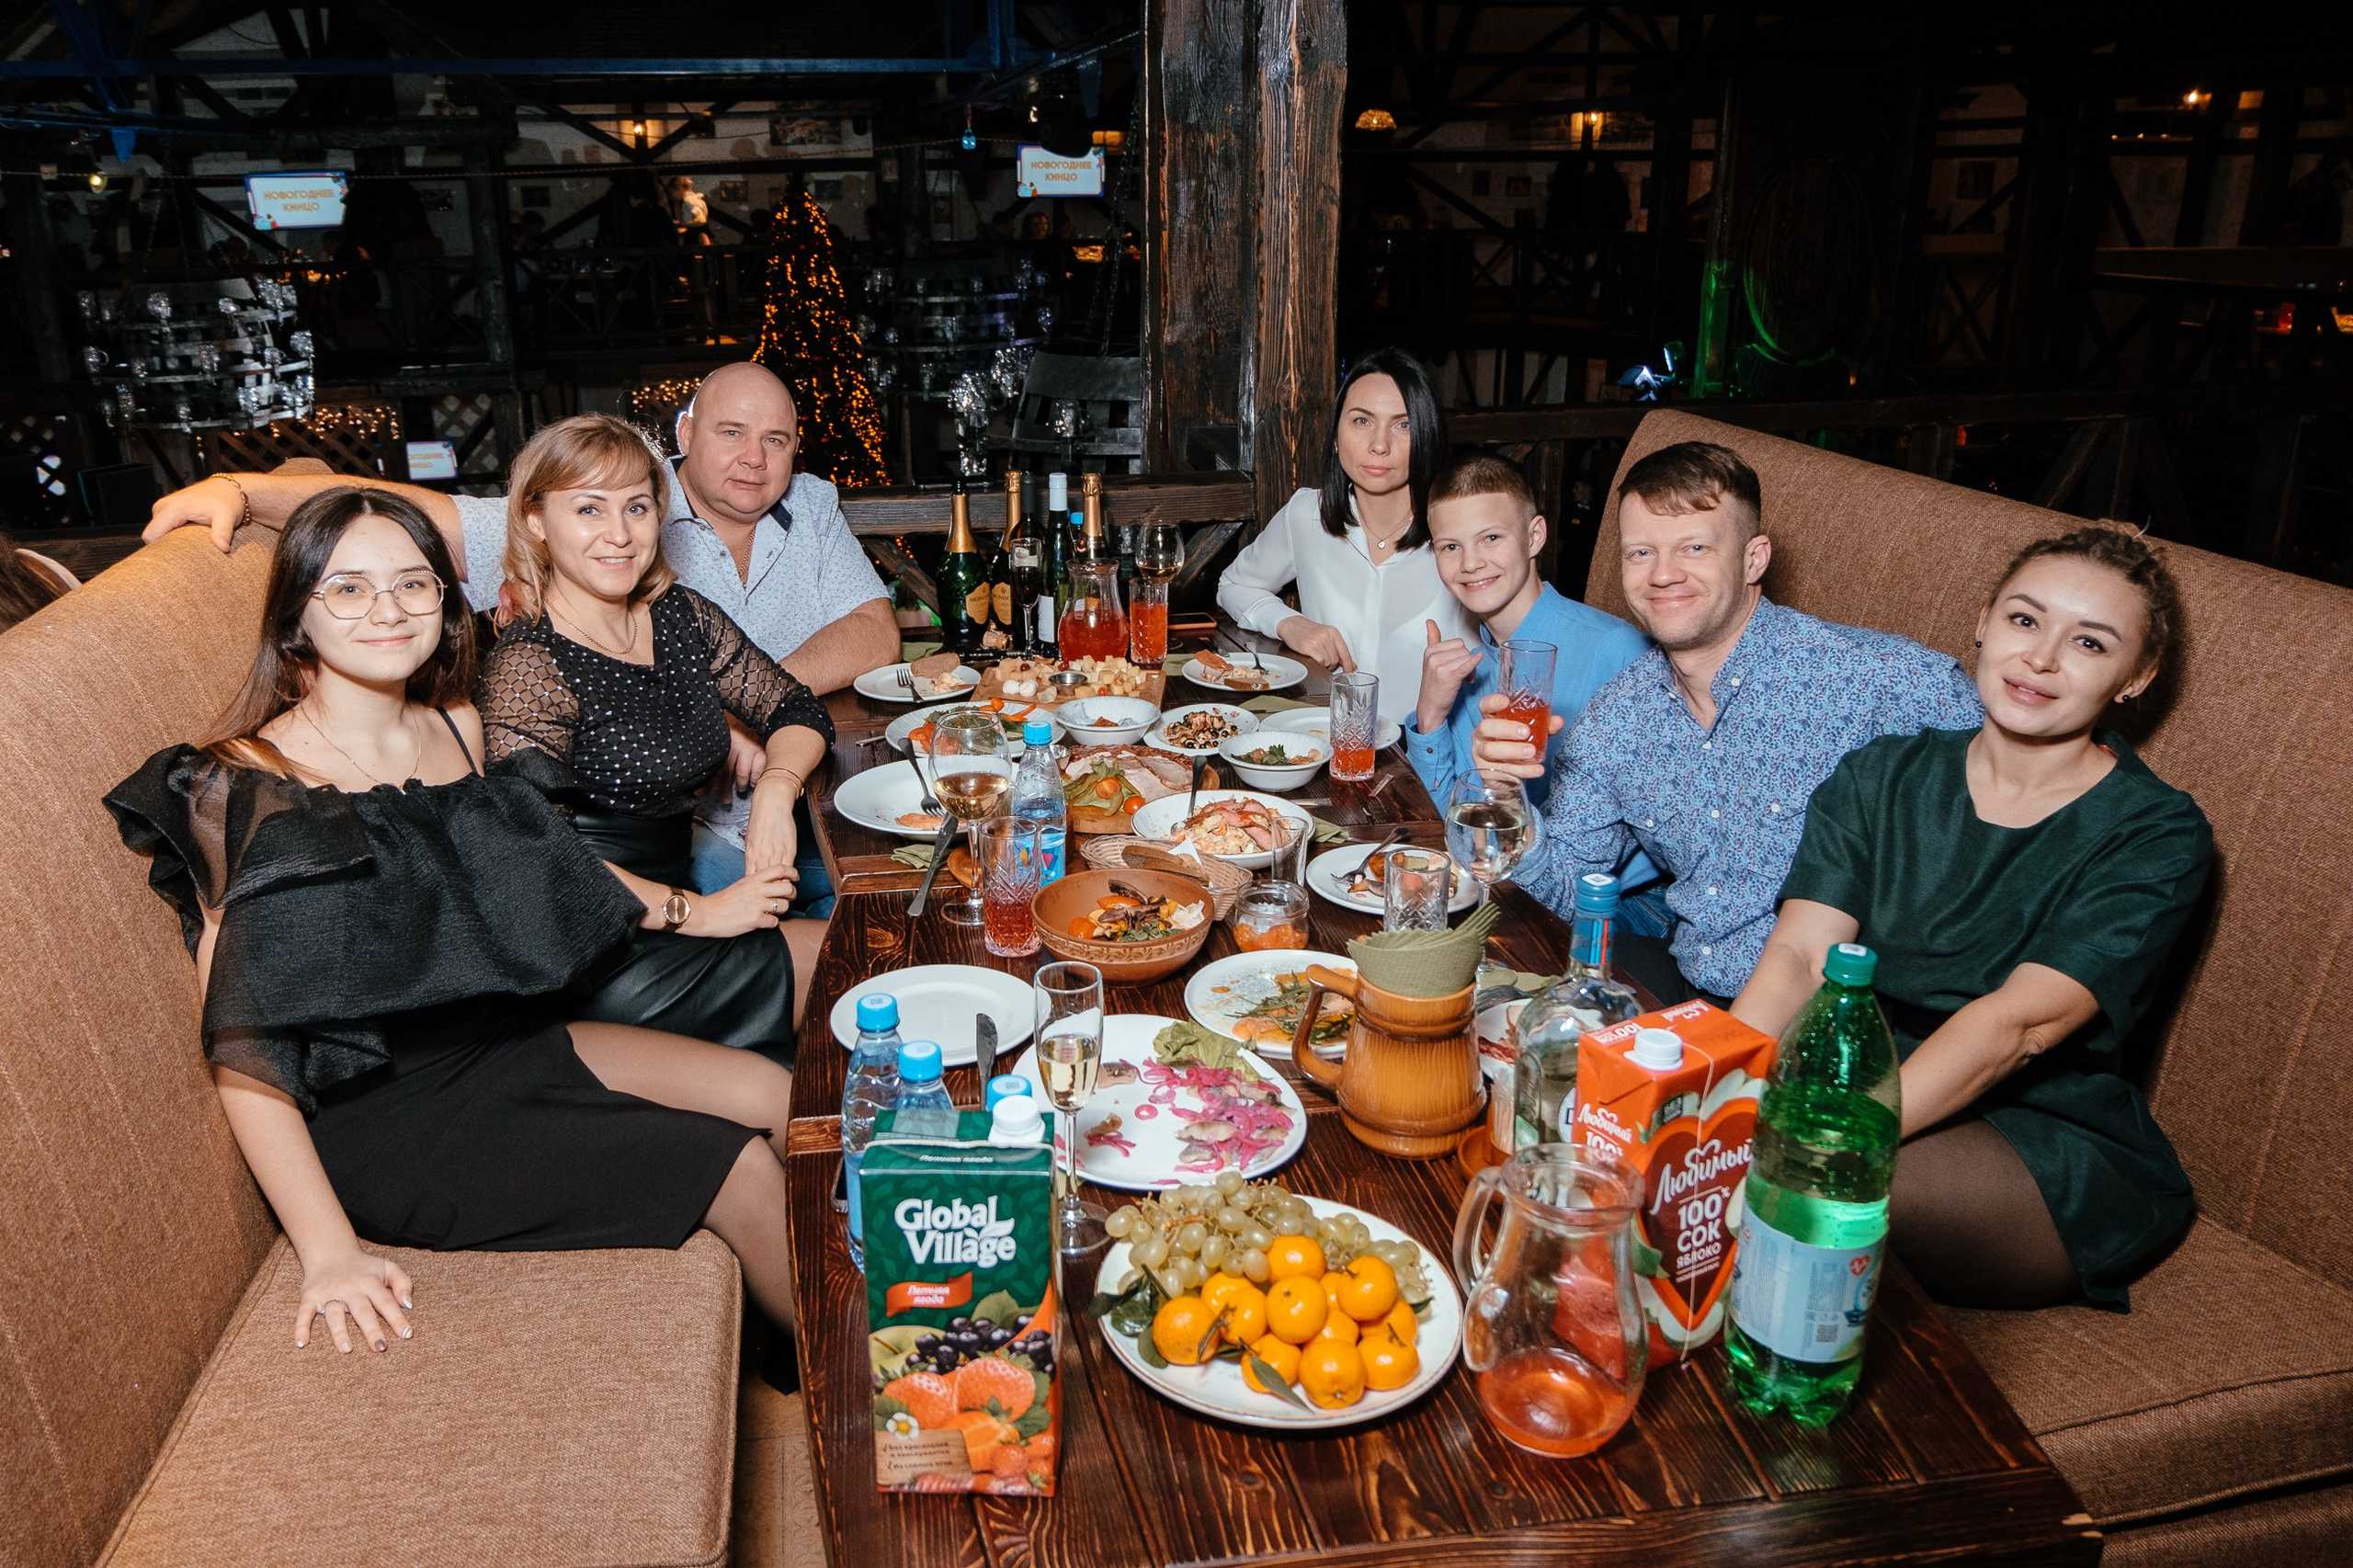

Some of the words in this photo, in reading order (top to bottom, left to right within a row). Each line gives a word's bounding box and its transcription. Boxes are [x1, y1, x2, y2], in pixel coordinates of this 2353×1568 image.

[1030, 161, 1092, 170] НОВОГОДНЕЕ
[263, 188, 335, 199] НОВОГОДНЕЕ
[1577, 1103, 1632, 1144] Любимый
[1649, 1138, 1753, 1216] Любимый
[894, 1195, 1015, 1231] Global
[904, 1230, 1017, 1267] Village
[1677, 1218, 1722, 1253] СОК
[1676, 1242, 1722, 1269] ЯБЛОКО
[907, 1285, 950, 1295] Летняя
[914, 1293, 945, 1305] ягода
